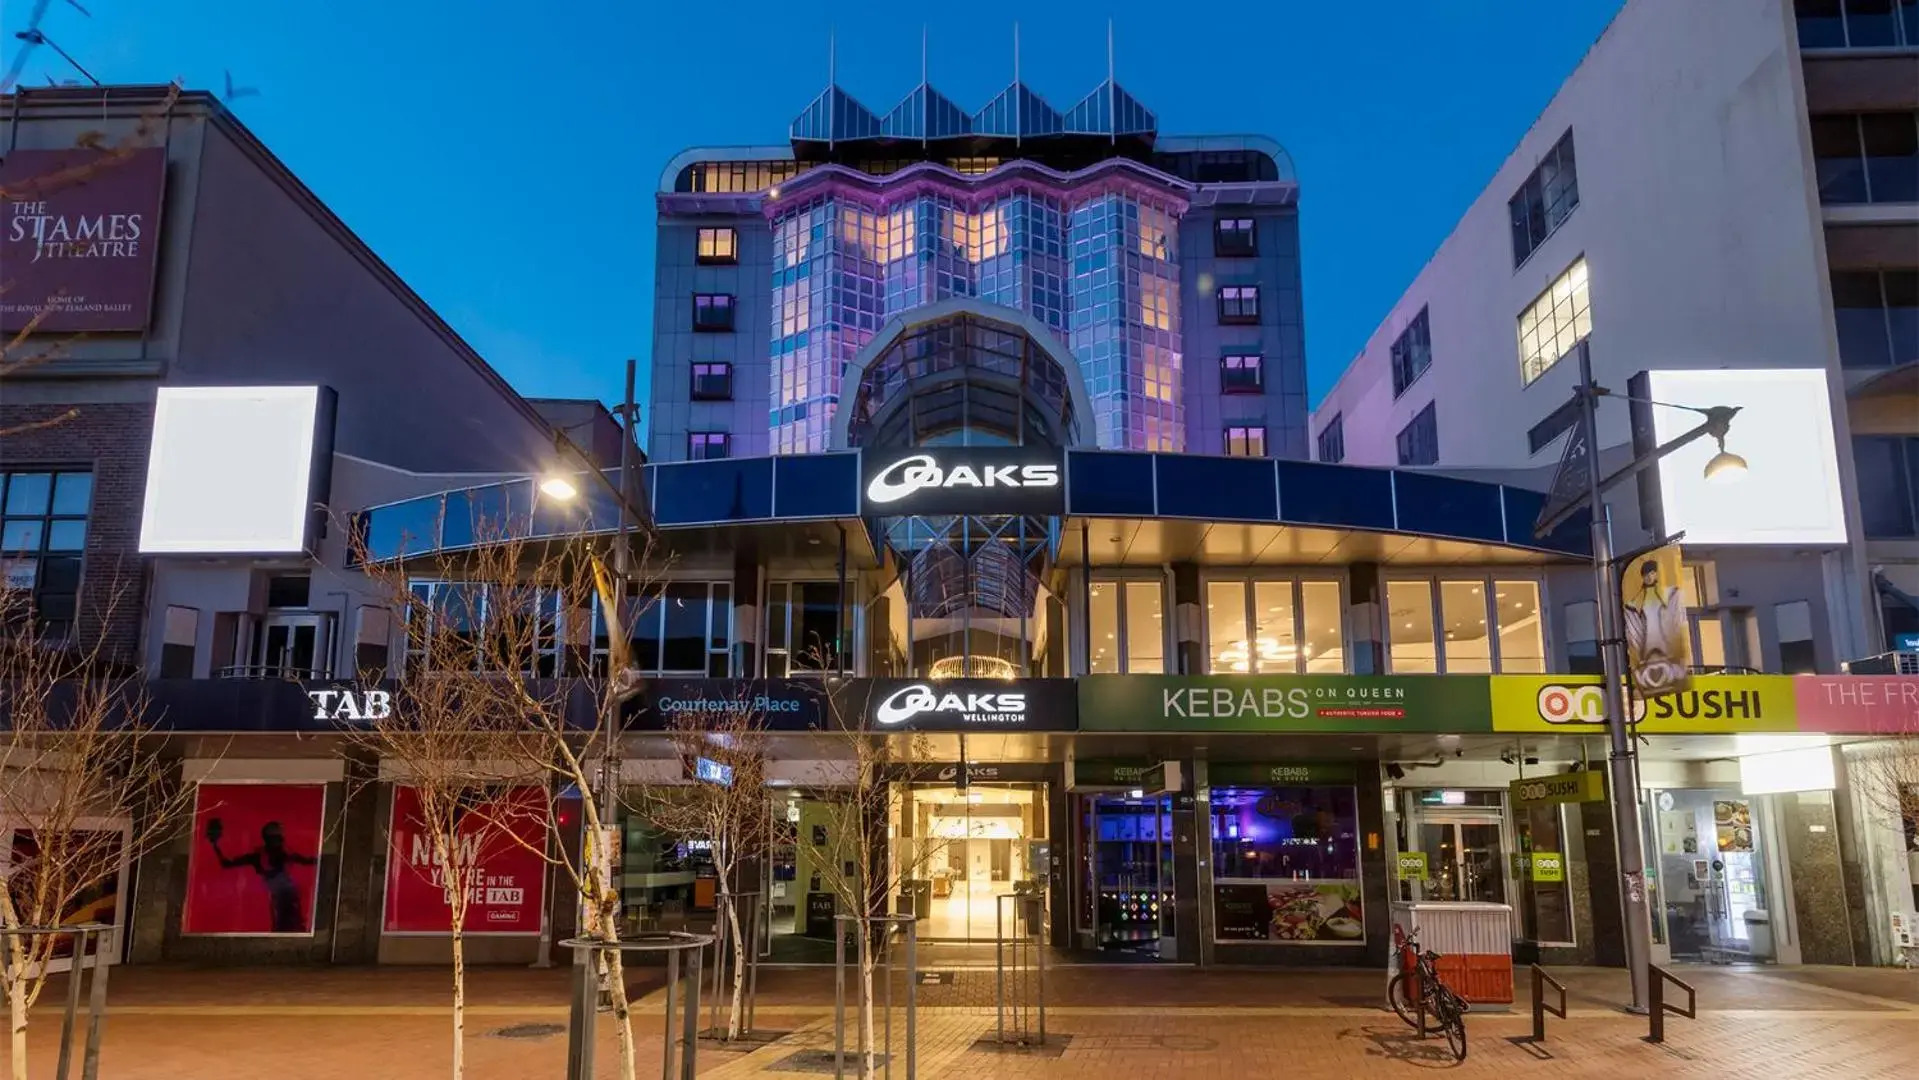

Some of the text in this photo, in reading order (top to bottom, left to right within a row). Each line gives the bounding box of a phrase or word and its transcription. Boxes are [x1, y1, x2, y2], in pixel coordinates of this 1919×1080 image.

[12, 201, 47, 215] THE
[45, 241, 139, 258] THEATRE
[868, 455, 1059, 503] OAKS
[1316, 688, 1404, 698] ON QUEEN
[1821, 682, 1876, 705] THE
[308, 690, 391, 719] TAB
[658, 695, 800, 716] Courtenay Place
[877, 685, 1026, 724] OAKS
[1163, 688, 1310, 718] KEBABS
[1539, 685, 1762, 723] on SUSHI
[963, 714, 1025, 722] WELLINGTON
[1271, 767, 1309, 776] KEBABS
[1547, 781, 1579, 796] SUSHI
[487, 876, 496, 886] IN
[499, 876, 514, 886] THE
[444, 887, 520, 904] GME TAB
